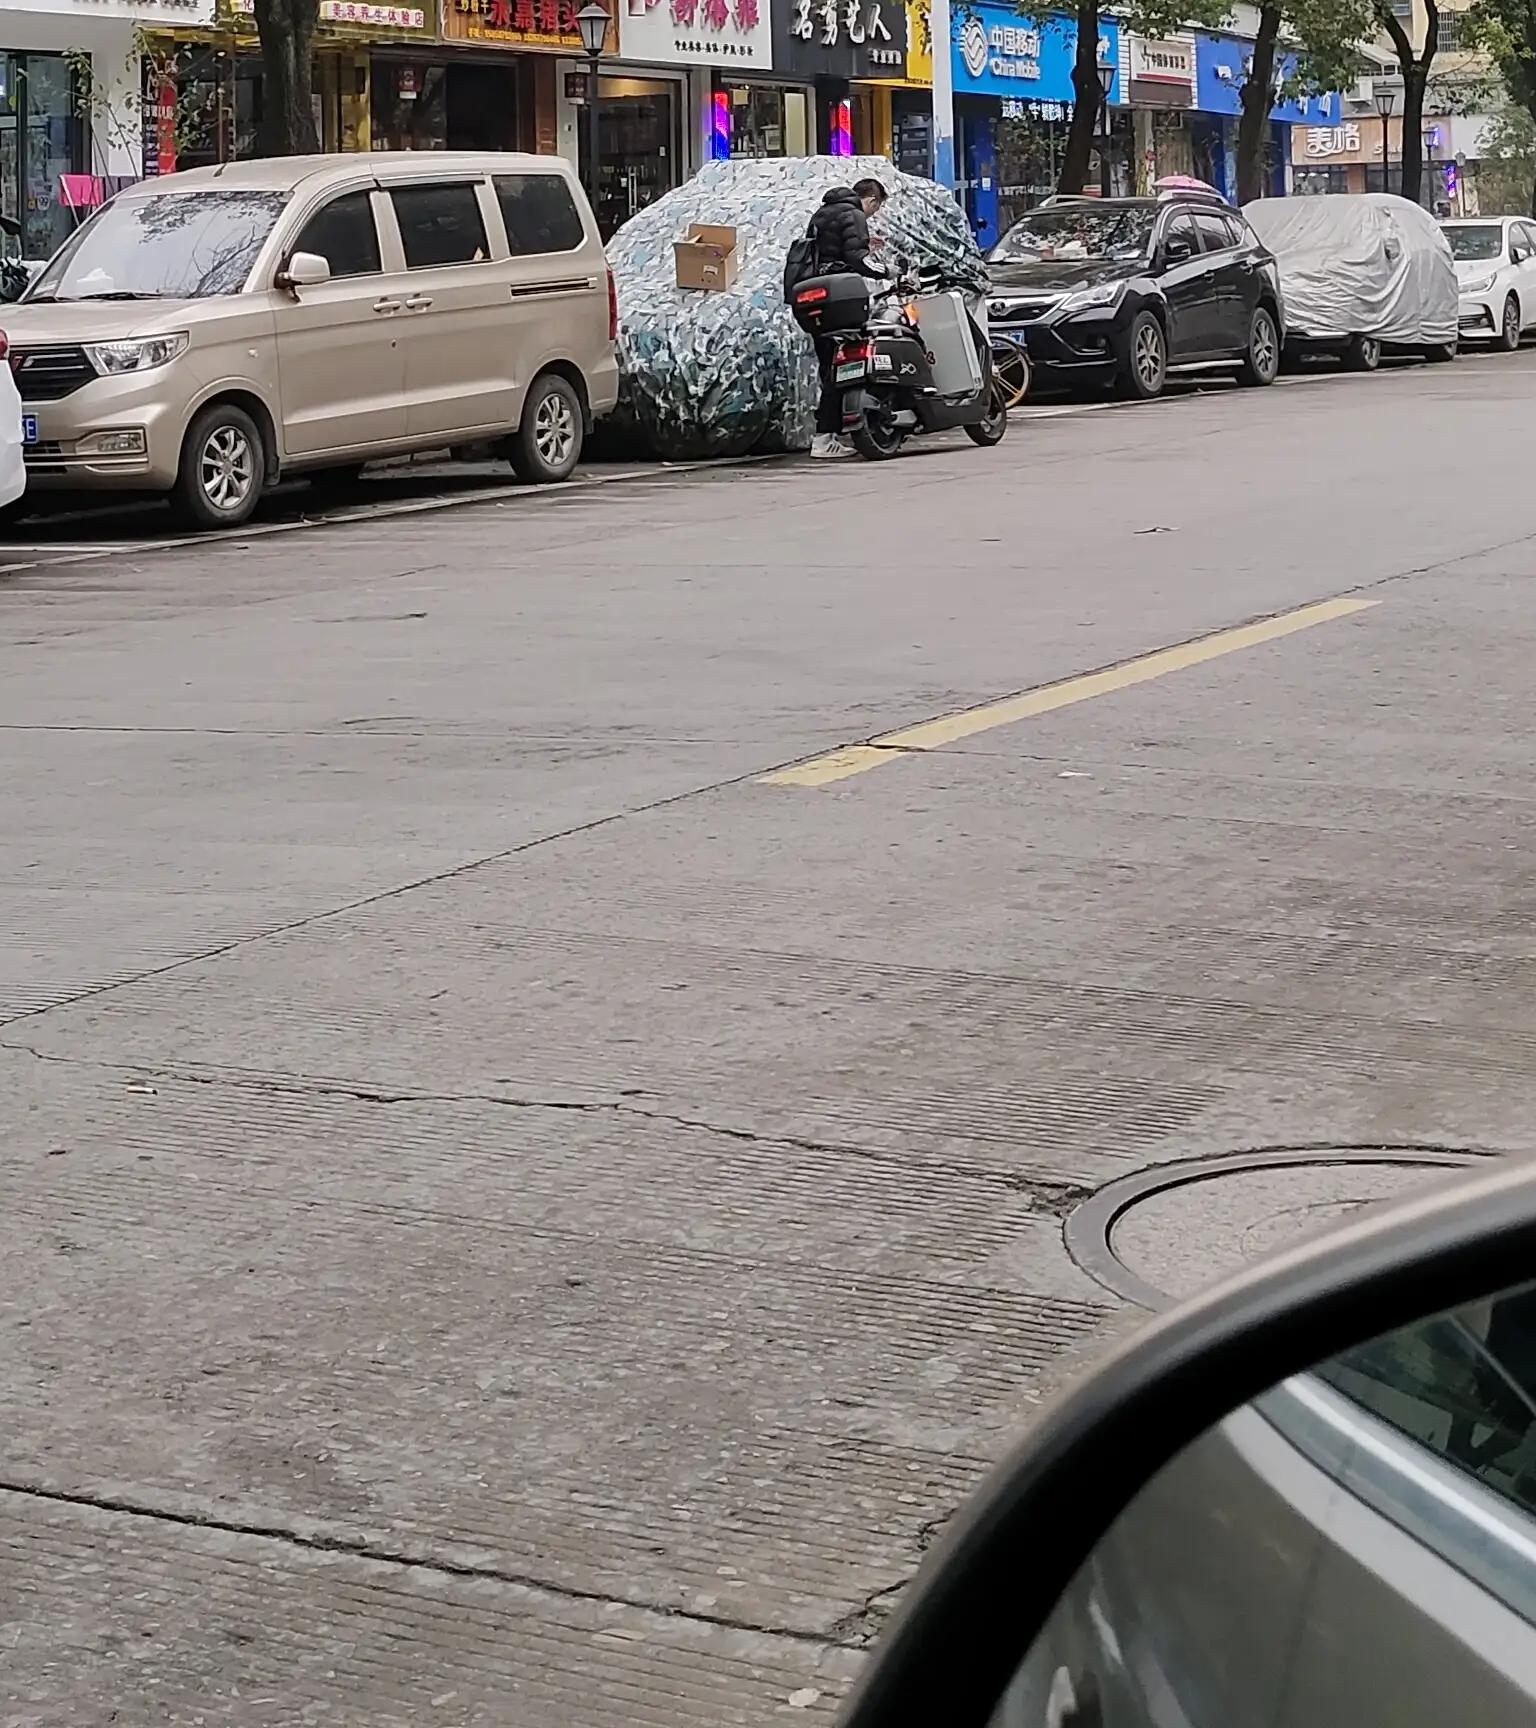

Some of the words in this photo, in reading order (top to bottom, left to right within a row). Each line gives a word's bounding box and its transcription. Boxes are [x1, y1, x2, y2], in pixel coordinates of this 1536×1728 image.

[990, 25, 1041, 57] 中国移动
[1304, 124, 1361, 158] 美格
